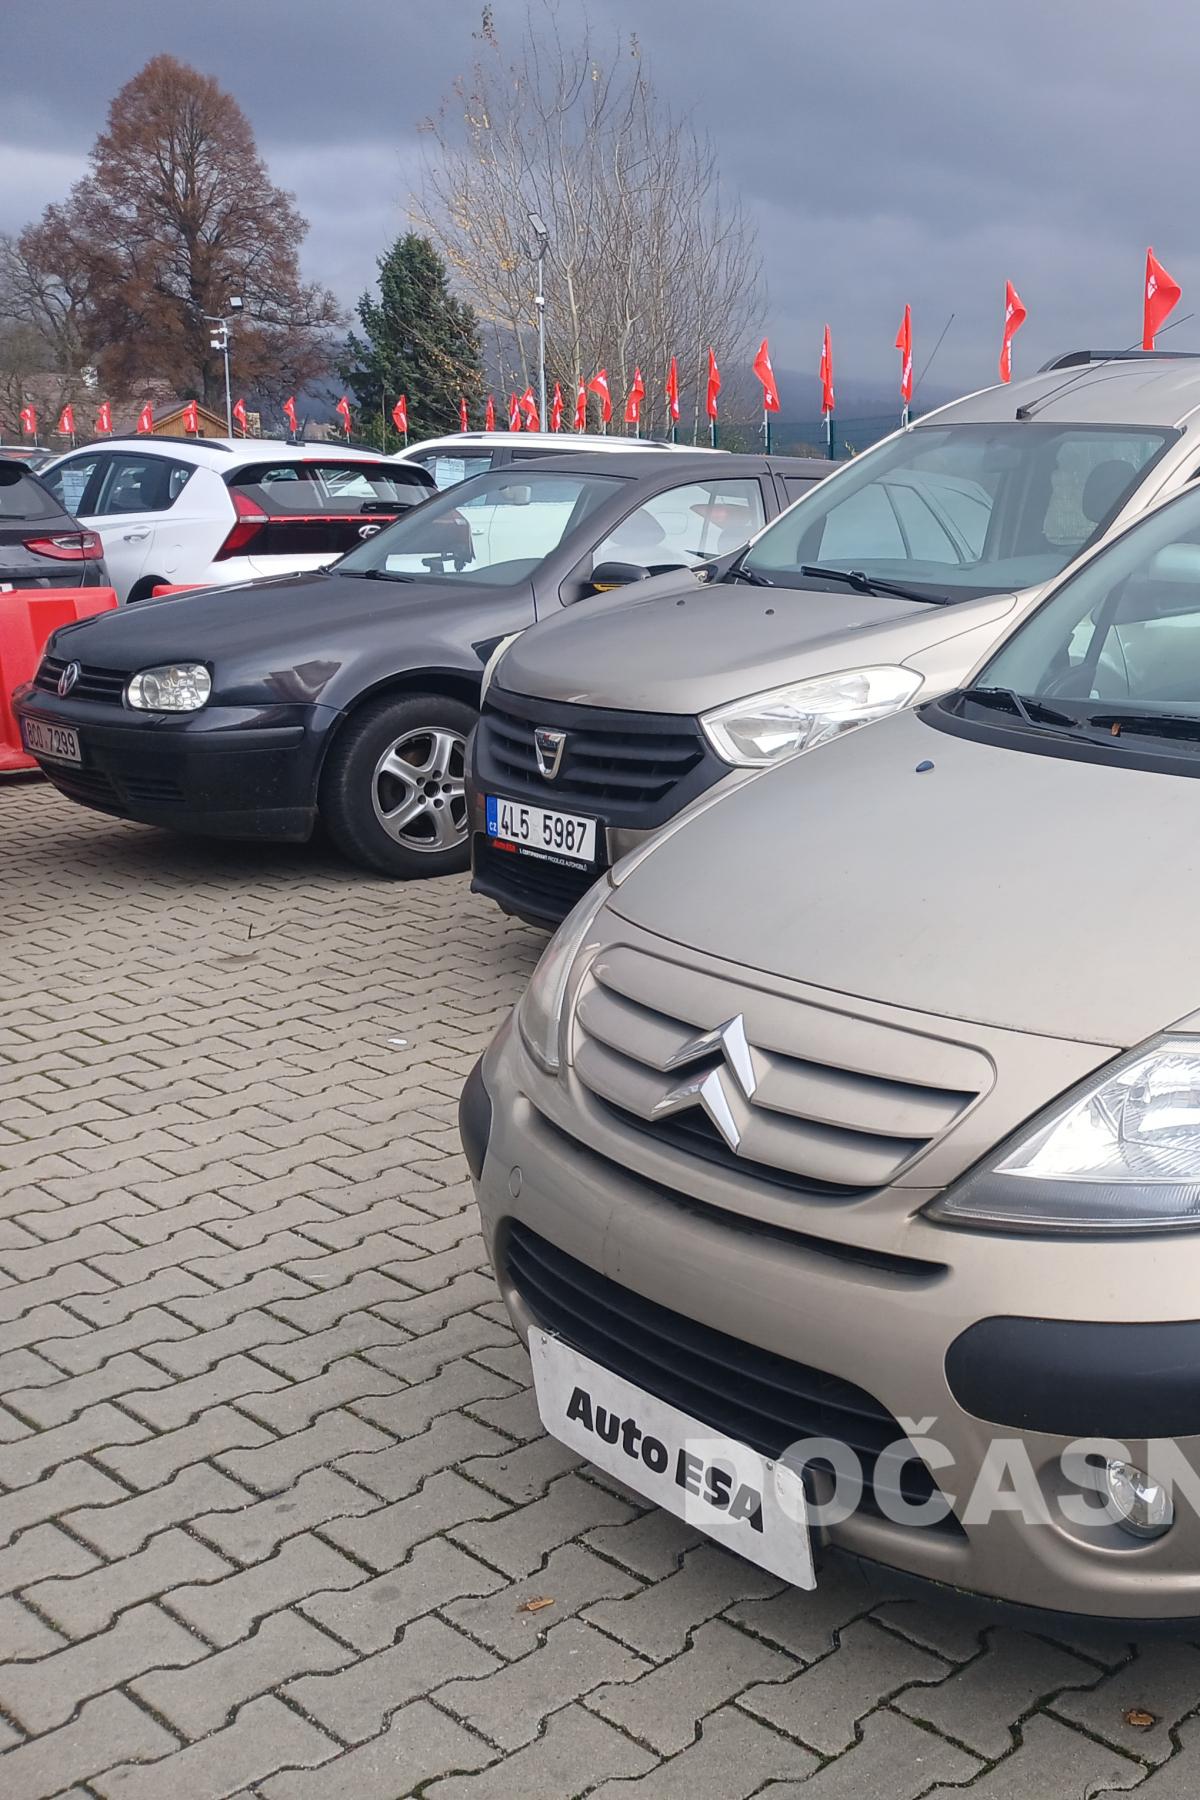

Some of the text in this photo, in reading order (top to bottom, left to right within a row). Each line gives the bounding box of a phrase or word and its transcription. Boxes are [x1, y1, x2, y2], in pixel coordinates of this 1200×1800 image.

[47, 727, 76, 757] 7299
[489, 821, 497, 832] CZ
[501, 804, 587, 853] 4L5 5987
[566, 1386, 764, 1534] Auto ESA
